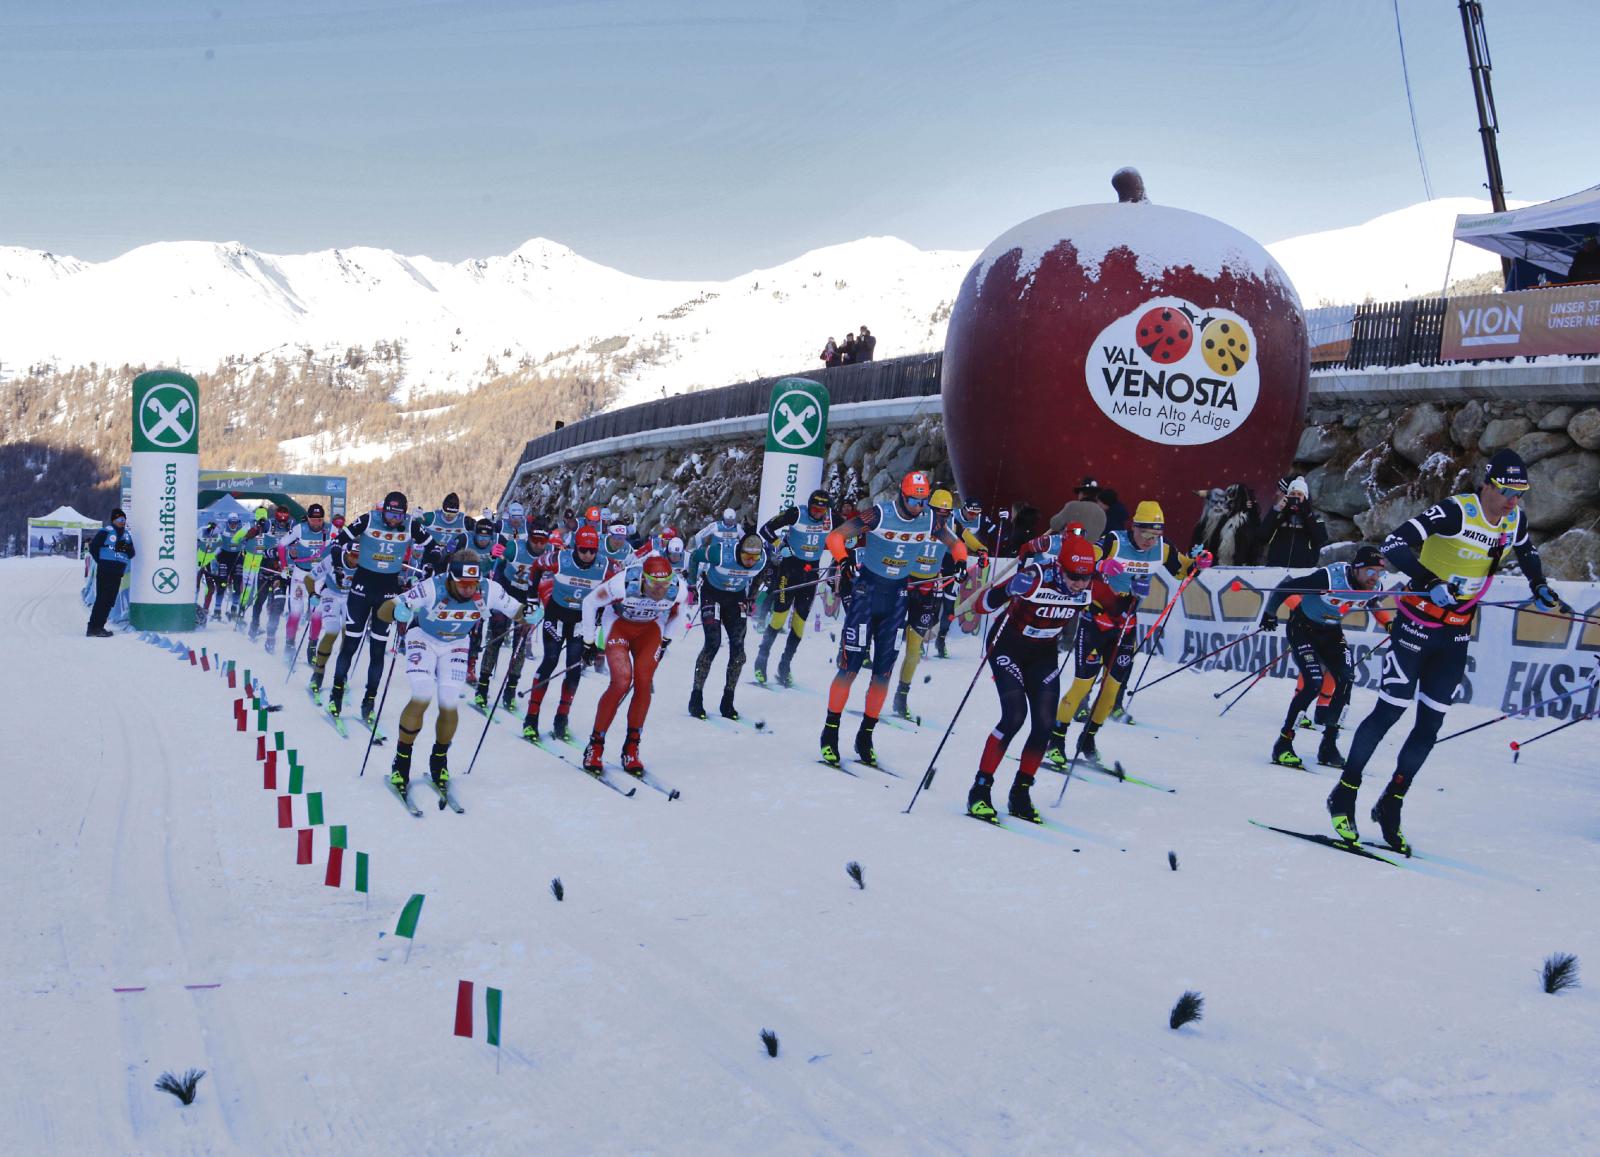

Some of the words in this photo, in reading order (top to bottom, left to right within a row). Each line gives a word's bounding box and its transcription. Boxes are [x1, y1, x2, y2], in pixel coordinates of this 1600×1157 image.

[1550, 301, 1585, 314] UNSER
[1458, 304, 1524, 335] VION
[1548, 316, 1583, 328] UNSER
[1103, 346, 1139, 366] VAL
[1101, 367, 1238, 412] VENOSTA
[1112, 401, 1151, 417] Mela
[1156, 405, 1187, 421] Alto
[1190, 410, 1231, 431] Adige
[1159, 421, 1186, 437] IGP
[158, 462, 177, 561] Raiffeisen
[806, 534, 819, 546] 18
[1462, 529, 1488, 544] WATCH
[379, 542, 395, 554] 15
[894, 544, 906, 559] 5
[923, 544, 937, 558] 11
[573, 589, 583, 599] 6
[1036, 592, 1058, 600] WATCH
[1035, 606, 1076, 619] CLIMB
[451, 622, 462, 633] 7
[1401, 623, 1429, 640] Moelven
